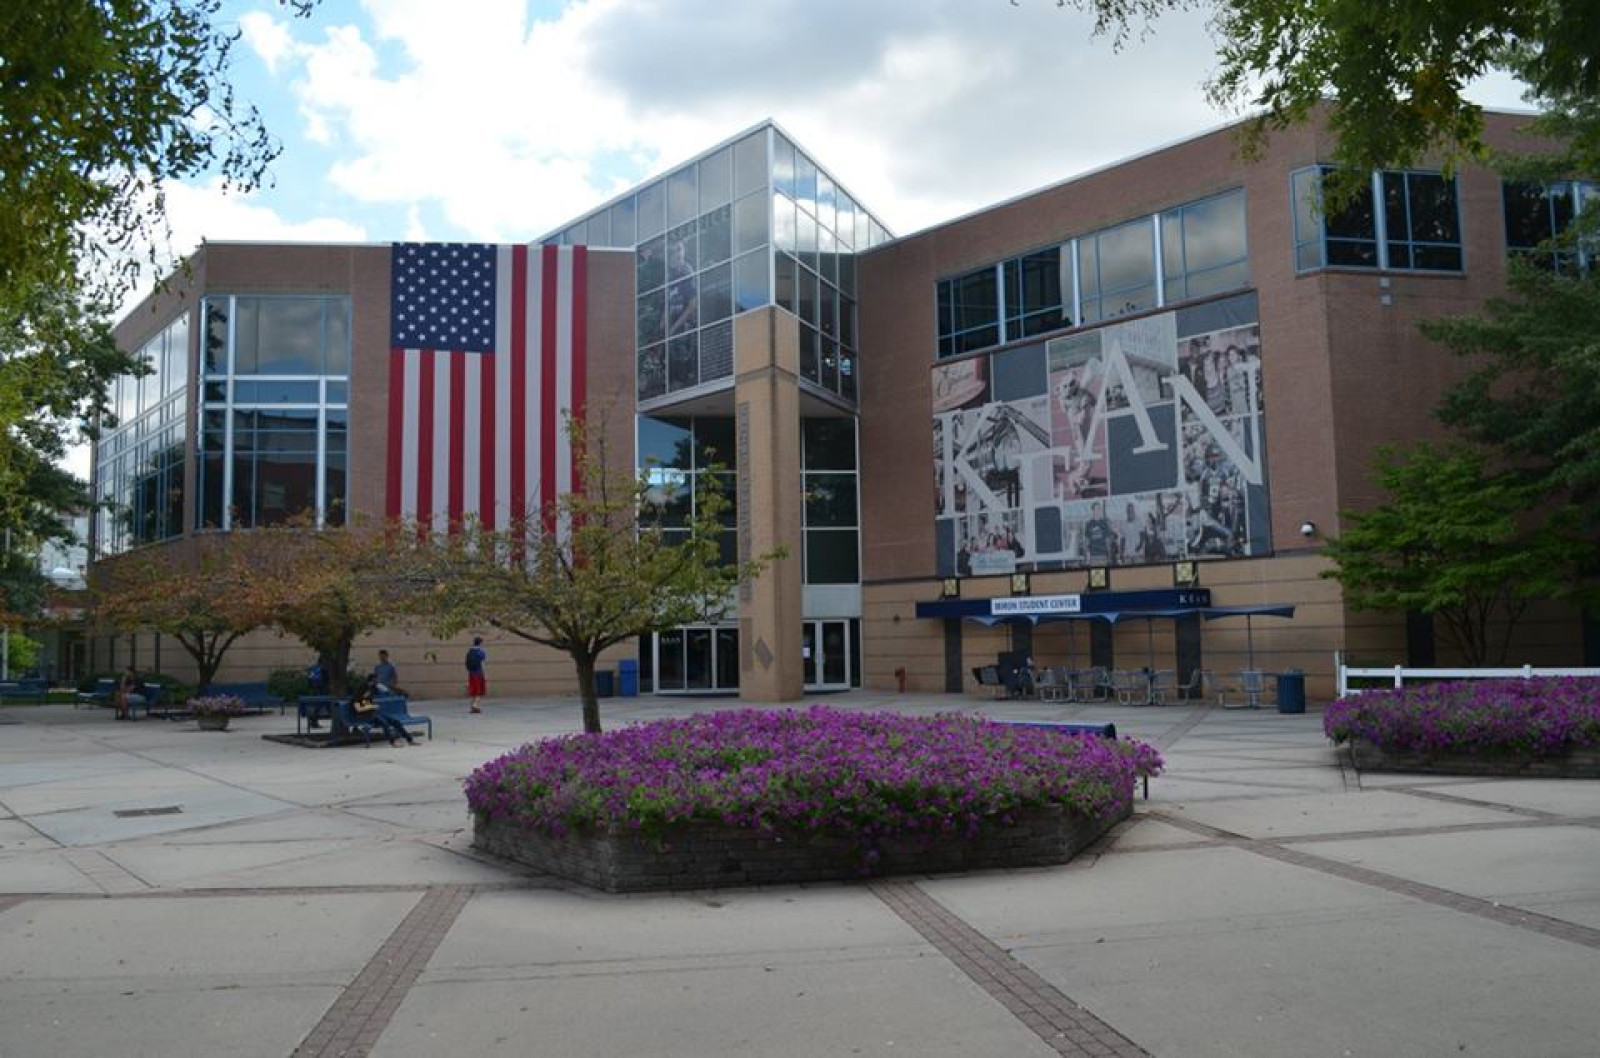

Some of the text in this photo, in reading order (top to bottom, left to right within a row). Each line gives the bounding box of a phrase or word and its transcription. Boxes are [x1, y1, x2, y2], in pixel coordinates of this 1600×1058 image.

[935, 341, 1264, 562] KEAN
[1019, 599, 1048, 609] STUDENT
[1050, 597, 1078, 608] CENTER
